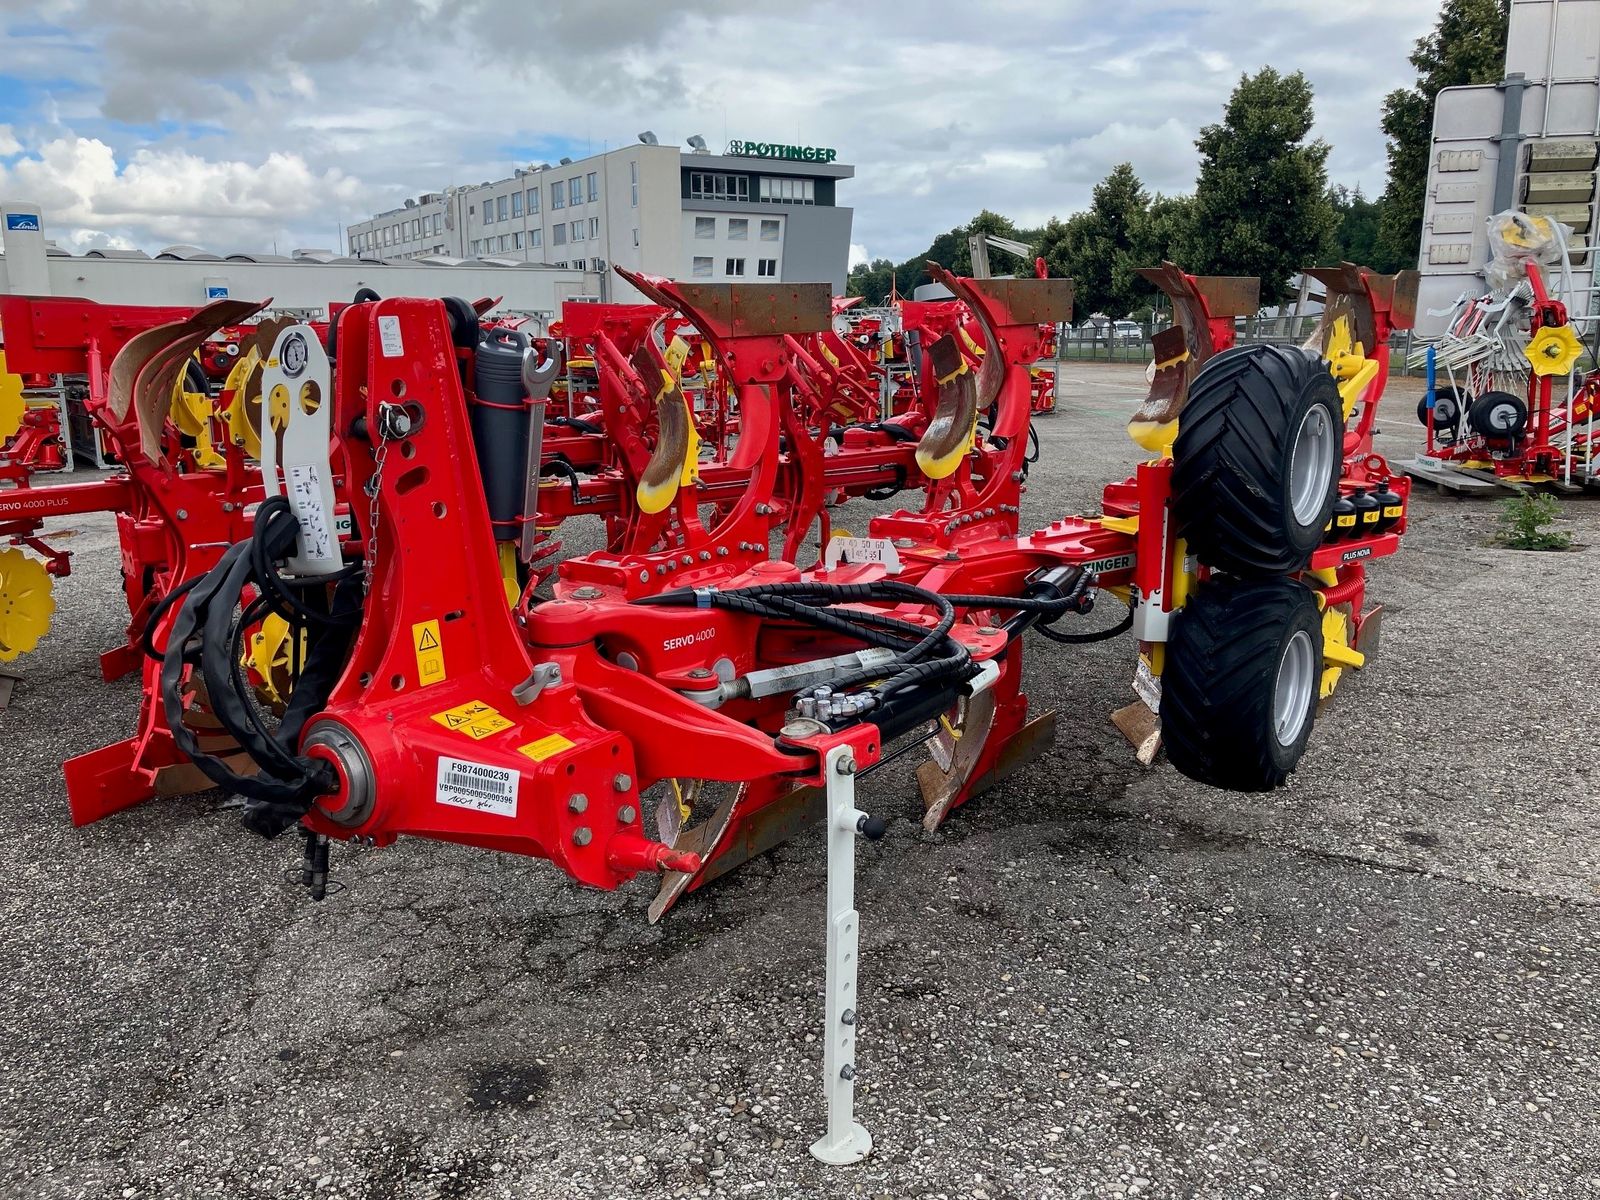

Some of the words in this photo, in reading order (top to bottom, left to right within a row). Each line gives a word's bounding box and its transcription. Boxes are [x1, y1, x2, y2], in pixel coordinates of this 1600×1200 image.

[22, 500, 45, 509] 4000
[47, 497, 69, 506] PLUS
[861, 540, 871, 549] 50
[875, 541, 885, 549] 60
[1343, 551, 1357, 561] PLUS
[1357, 548, 1371, 557] NOVA
[663, 634, 695, 651] SERVO
[695, 627, 716, 642] 4000
[451, 762, 509, 782] F9874000239
[439, 783, 513, 805] VBP00050005000396
